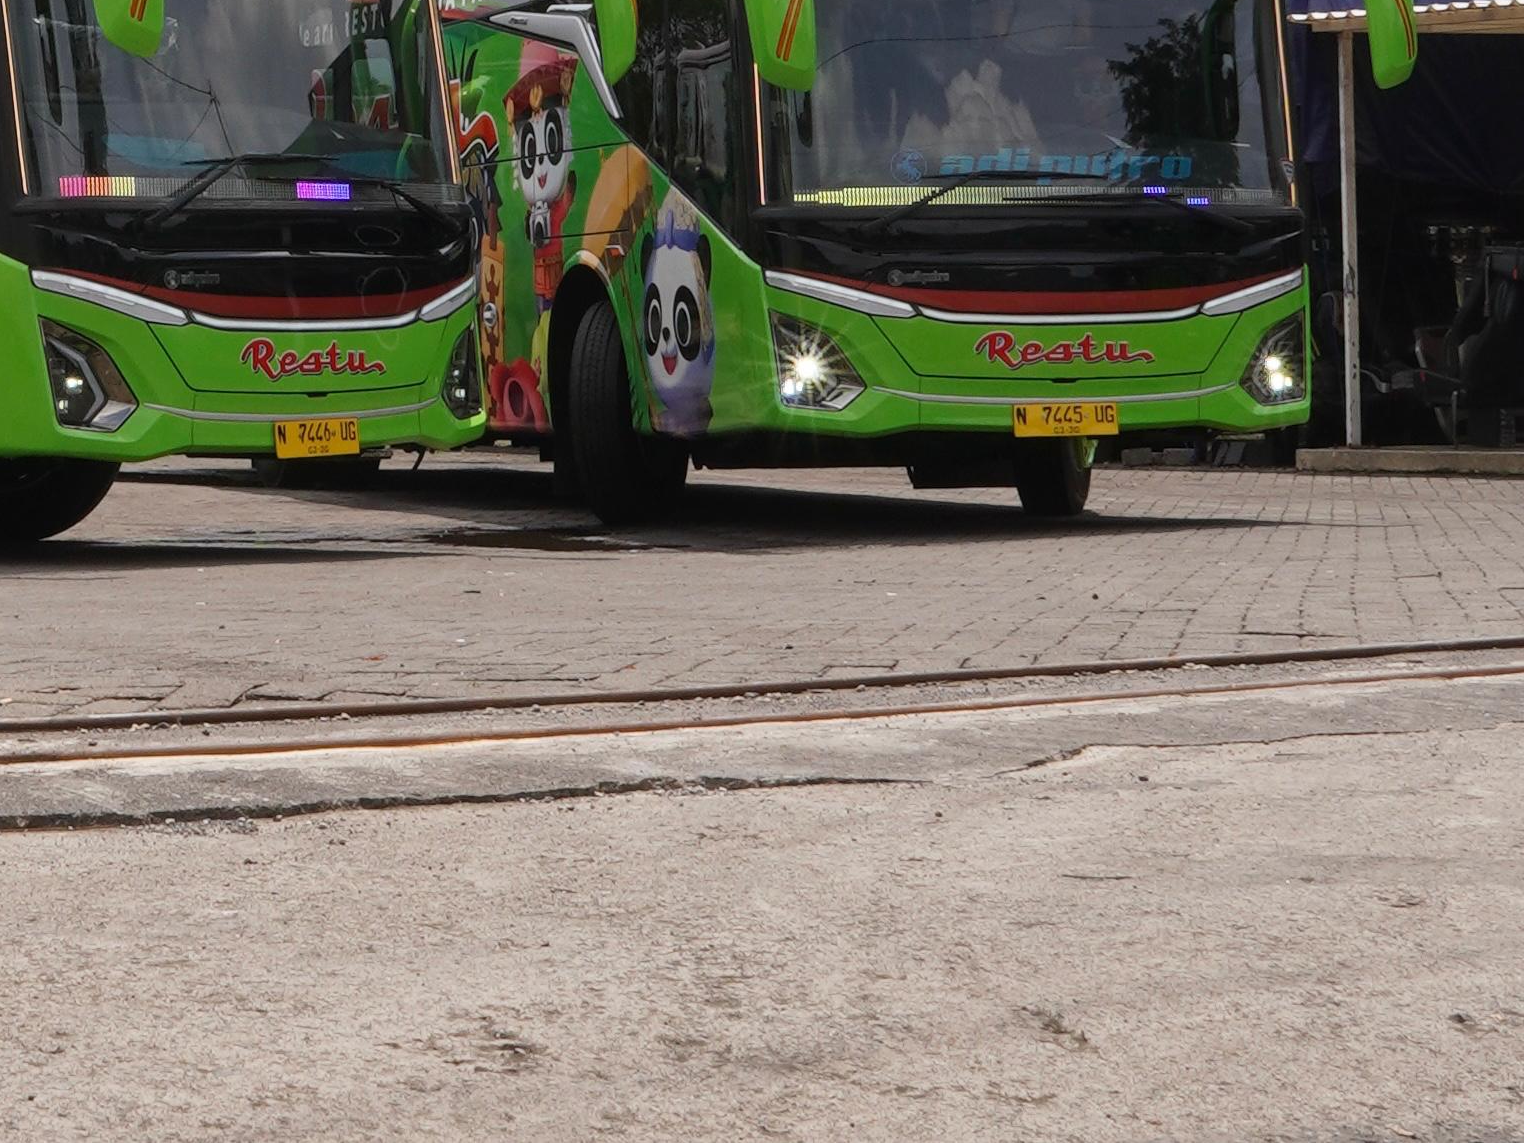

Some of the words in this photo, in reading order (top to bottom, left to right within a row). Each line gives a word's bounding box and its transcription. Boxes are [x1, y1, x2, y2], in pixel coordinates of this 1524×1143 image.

[939, 147, 1030, 175] adi
[1036, 147, 1192, 186] putro
[240, 337, 387, 381] Restu
[974, 330, 1155, 371] Restu
[277, 424, 288, 445] N
[299, 421, 331, 444] 7446
[339, 420, 357, 441] UG
[1016, 407, 1027, 425] N
[1042, 405, 1083, 424] 7445
[1094, 405, 1115, 423] UG
